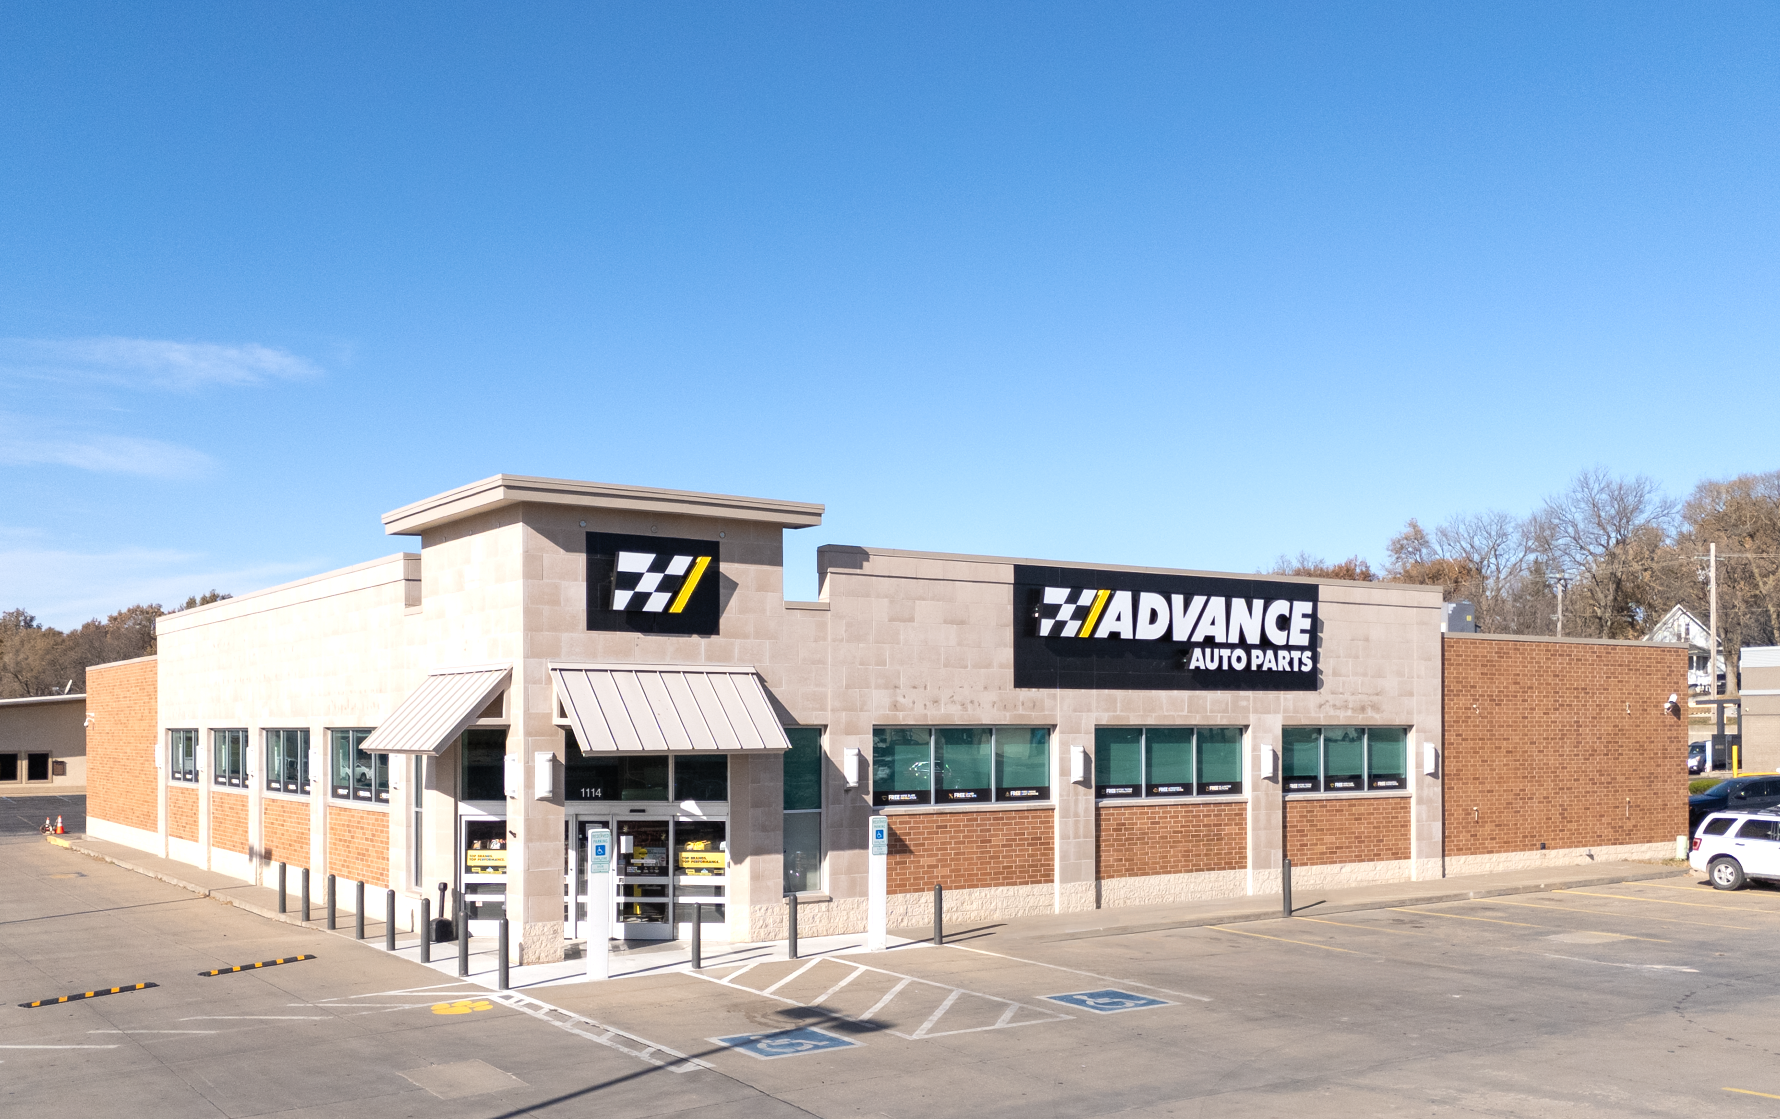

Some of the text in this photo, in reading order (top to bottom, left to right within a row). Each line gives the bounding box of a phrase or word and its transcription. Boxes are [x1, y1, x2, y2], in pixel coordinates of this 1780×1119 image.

[1094, 590, 1313, 646] ADVANCE
[1189, 648, 1313, 672] AUTO PARTS
[580, 788, 602, 797] 1114
